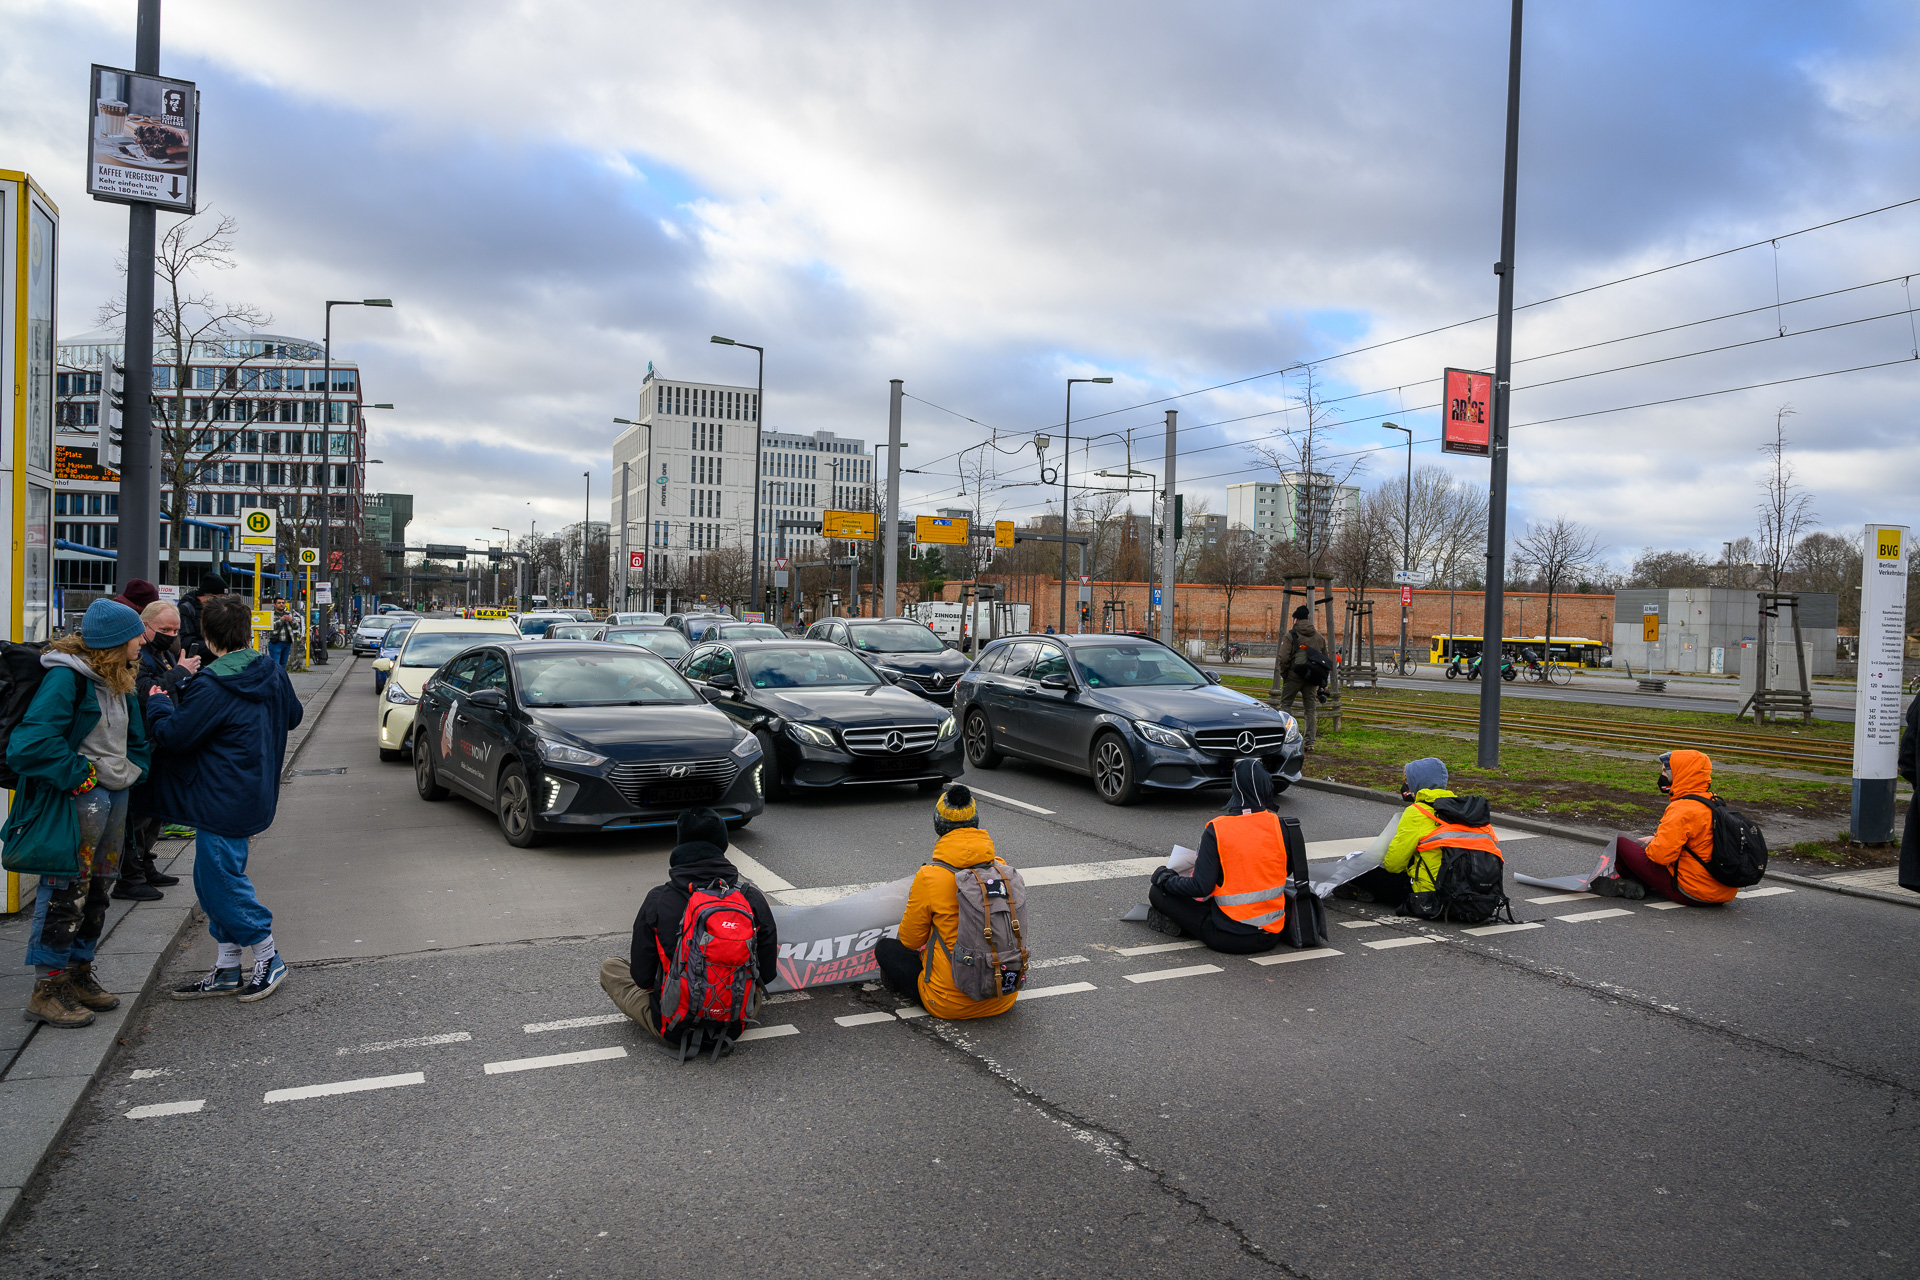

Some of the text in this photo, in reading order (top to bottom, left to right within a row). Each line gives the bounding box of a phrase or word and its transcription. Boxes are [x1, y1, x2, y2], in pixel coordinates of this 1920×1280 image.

[162, 114, 184, 122] COFFEE
[99, 166, 164, 183] KAFFEE VERGESSEN?
[118, 180, 144, 188] einfach
[1452, 398, 1485, 424] ARISE
[55, 451, 83, 459] ch-Platz
[1880, 544, 1898, 556] BVG
